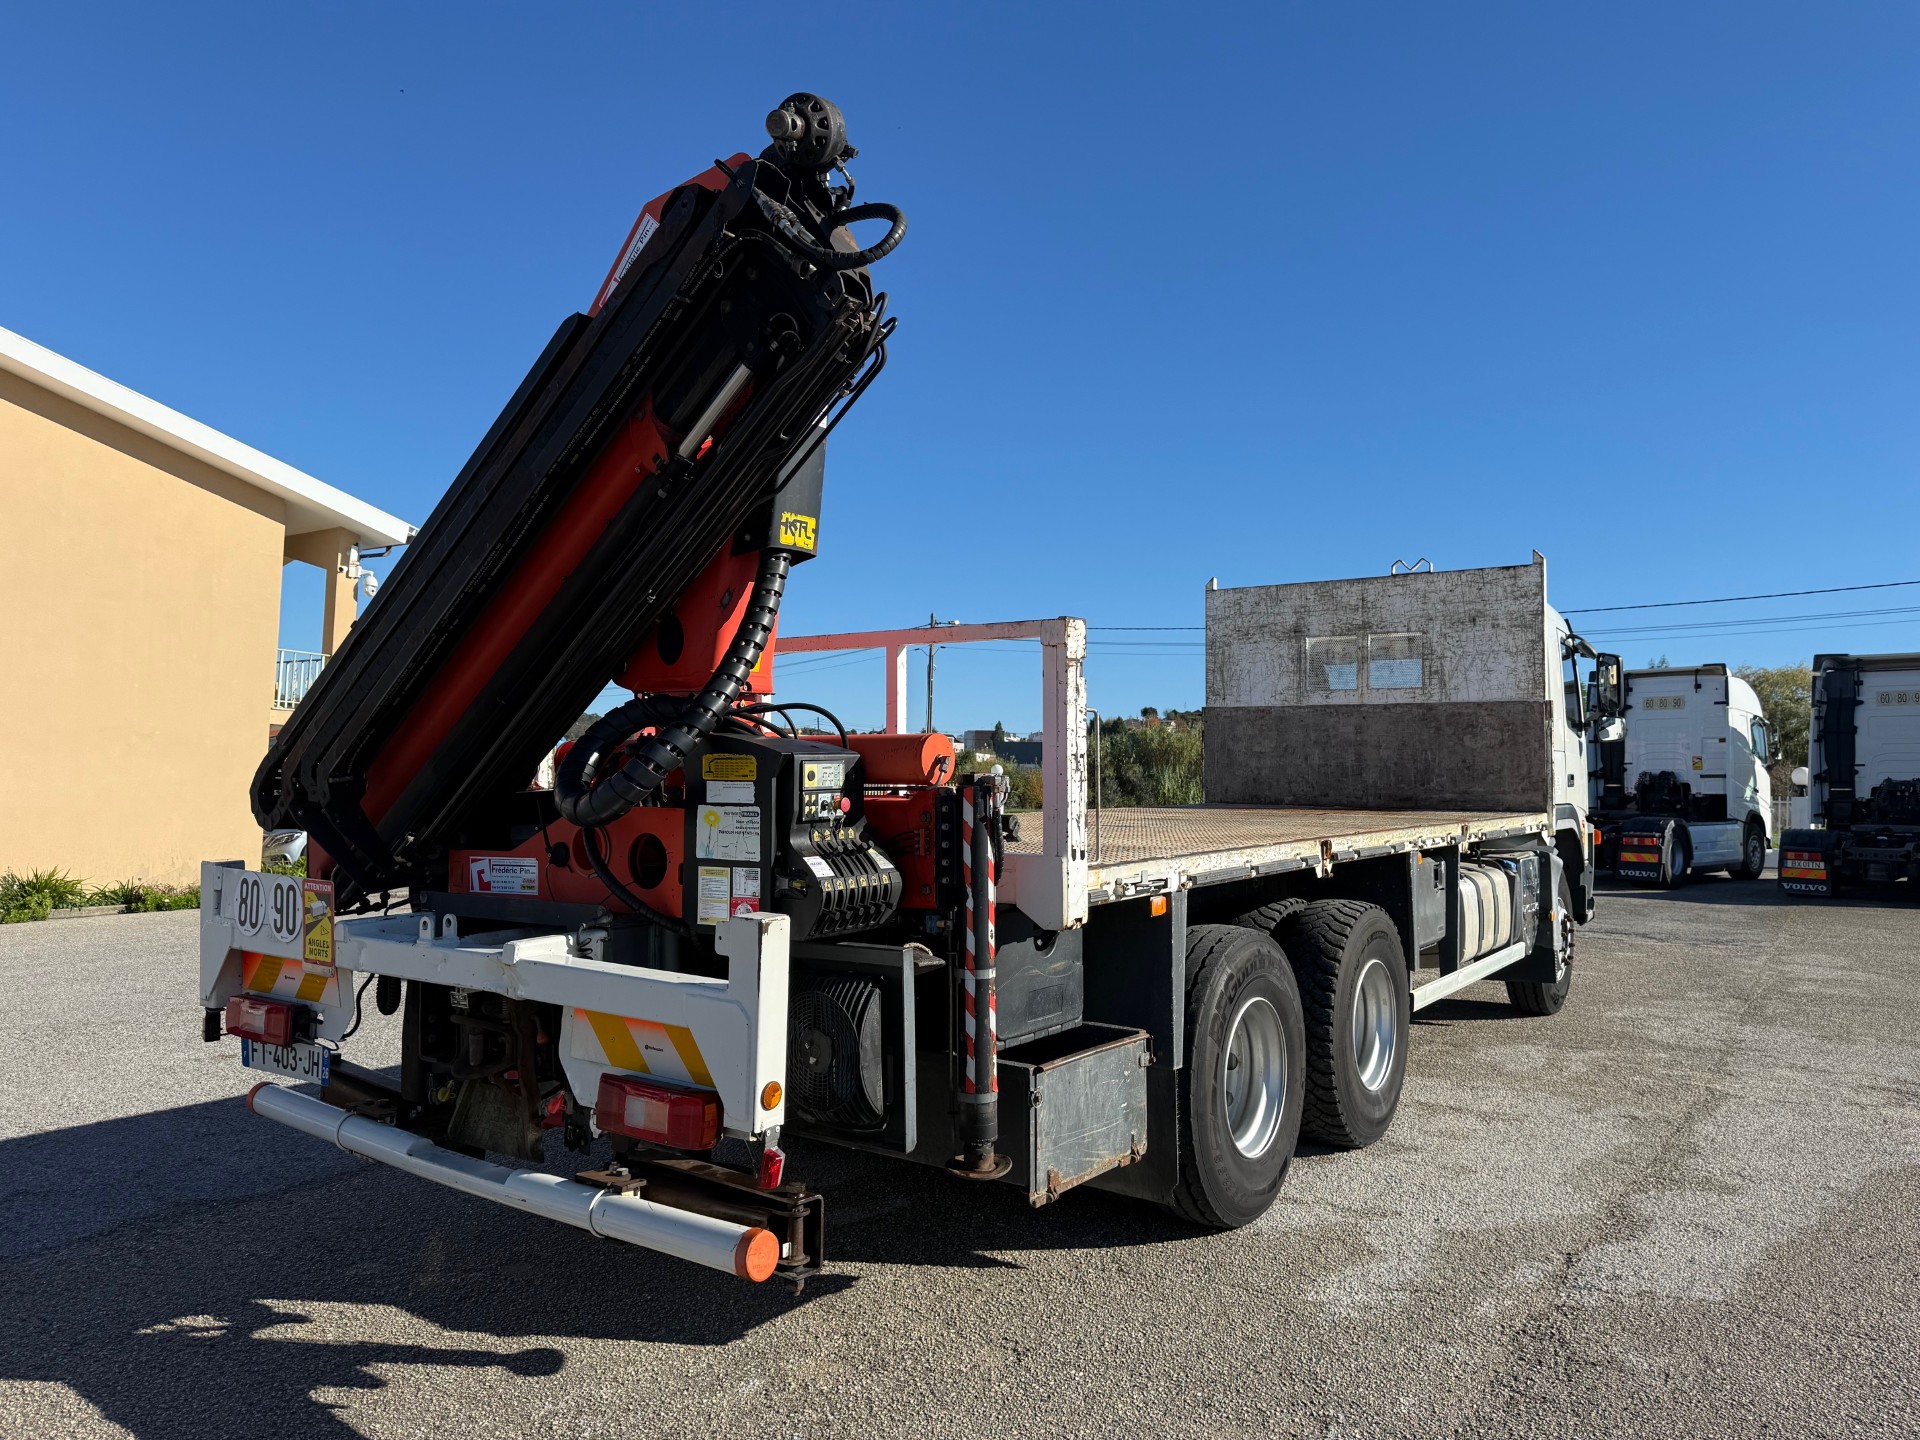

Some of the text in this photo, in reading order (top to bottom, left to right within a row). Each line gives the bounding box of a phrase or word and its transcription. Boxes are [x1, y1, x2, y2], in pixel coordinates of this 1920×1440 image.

[1880, 692, 1920, 703] 60 80 9
[1645, 698, 1681, 709] 60 80 90
[519, 867, 531, 875] Pin
[1619, 869, 1657, 878] VOLVO
[304, 882, 332, 892] ATTENTION
[1781, 882, 1827, 892] VOLVO
[238, 877, 260, 929] 80
[273, 882, 297, 936] 90
[308, 938, 330, 949] ANGLES
[308, 948, 329, 958] MORTS
[322, 1067, 329, 1079] 26
